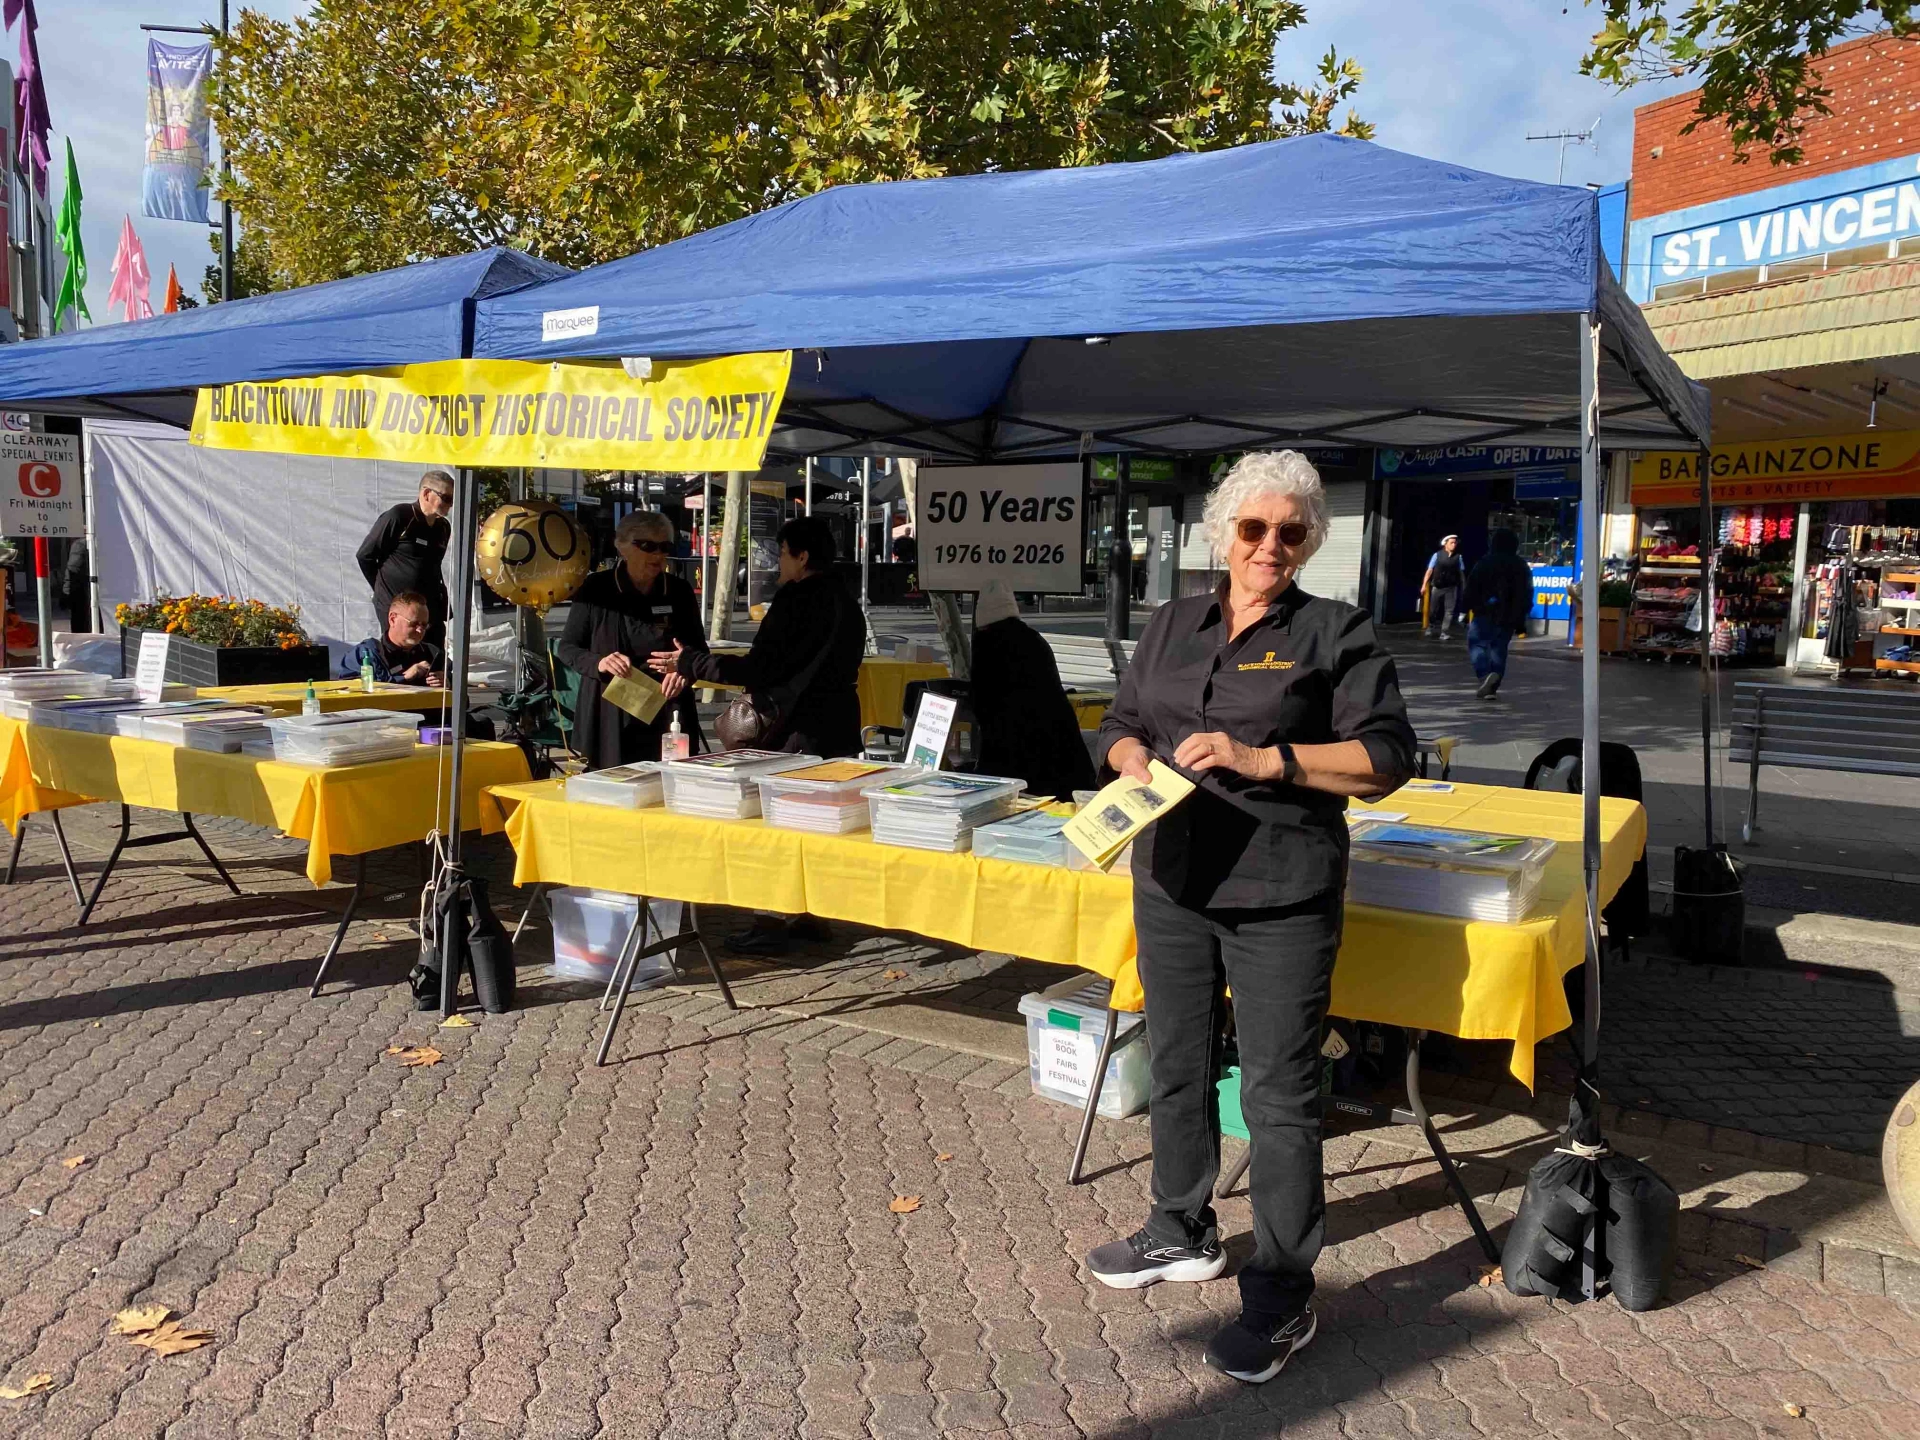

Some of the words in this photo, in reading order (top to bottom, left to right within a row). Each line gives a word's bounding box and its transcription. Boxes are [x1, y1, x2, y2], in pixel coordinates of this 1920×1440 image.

[1662, 227, 1726, 276] ST.
[211, 385, 323, 427] BLACKTOWN
[330, 388, 377, 429] AND
[381, 392, 485, 437] DISTRICT
[489, 392, 654, 442] HISTORICAL
[664, 390, 776, 442] SOCIETY
[3, 434, 69, 448] CLEARWAY
[2, 448, 38, 461] SPECIAL
[44, 450, 74, 462] EVENTS
[1493, 447, 1530, 465] OPEN
[1534, 448, 1542, 461] 7
[1129, 471, 1155, 480] emist
[1691, 484, 1737, 498] GFTS
[1763, 481, 1833, 495] VARIETY
[9, 498, 24, 509] Fri
[27, 499, 72, 512] Midnight
[927, 490, 968, 523] 50
[980, 489, 1076, 523] Years
[38, 513, 48, 521] to
[19, 524, 38, 534] Sat
[42, 525, 48, 534] 6
[52, 526, 68, 536] pm
[501, 509, 577, 566] 50
[935, 544, 982, 564] 1976
[988, 545, 1007, 564] to
[1012, 543, 1065, 565] 2026
[1536, 592, 1565, 606] BUY
[1055, 1044, 1078, 1056] BOOK
[1056, 1058, 1078, 1071] FAIRS
[1048, 1070, 1087, 1088] FESTIVALS
